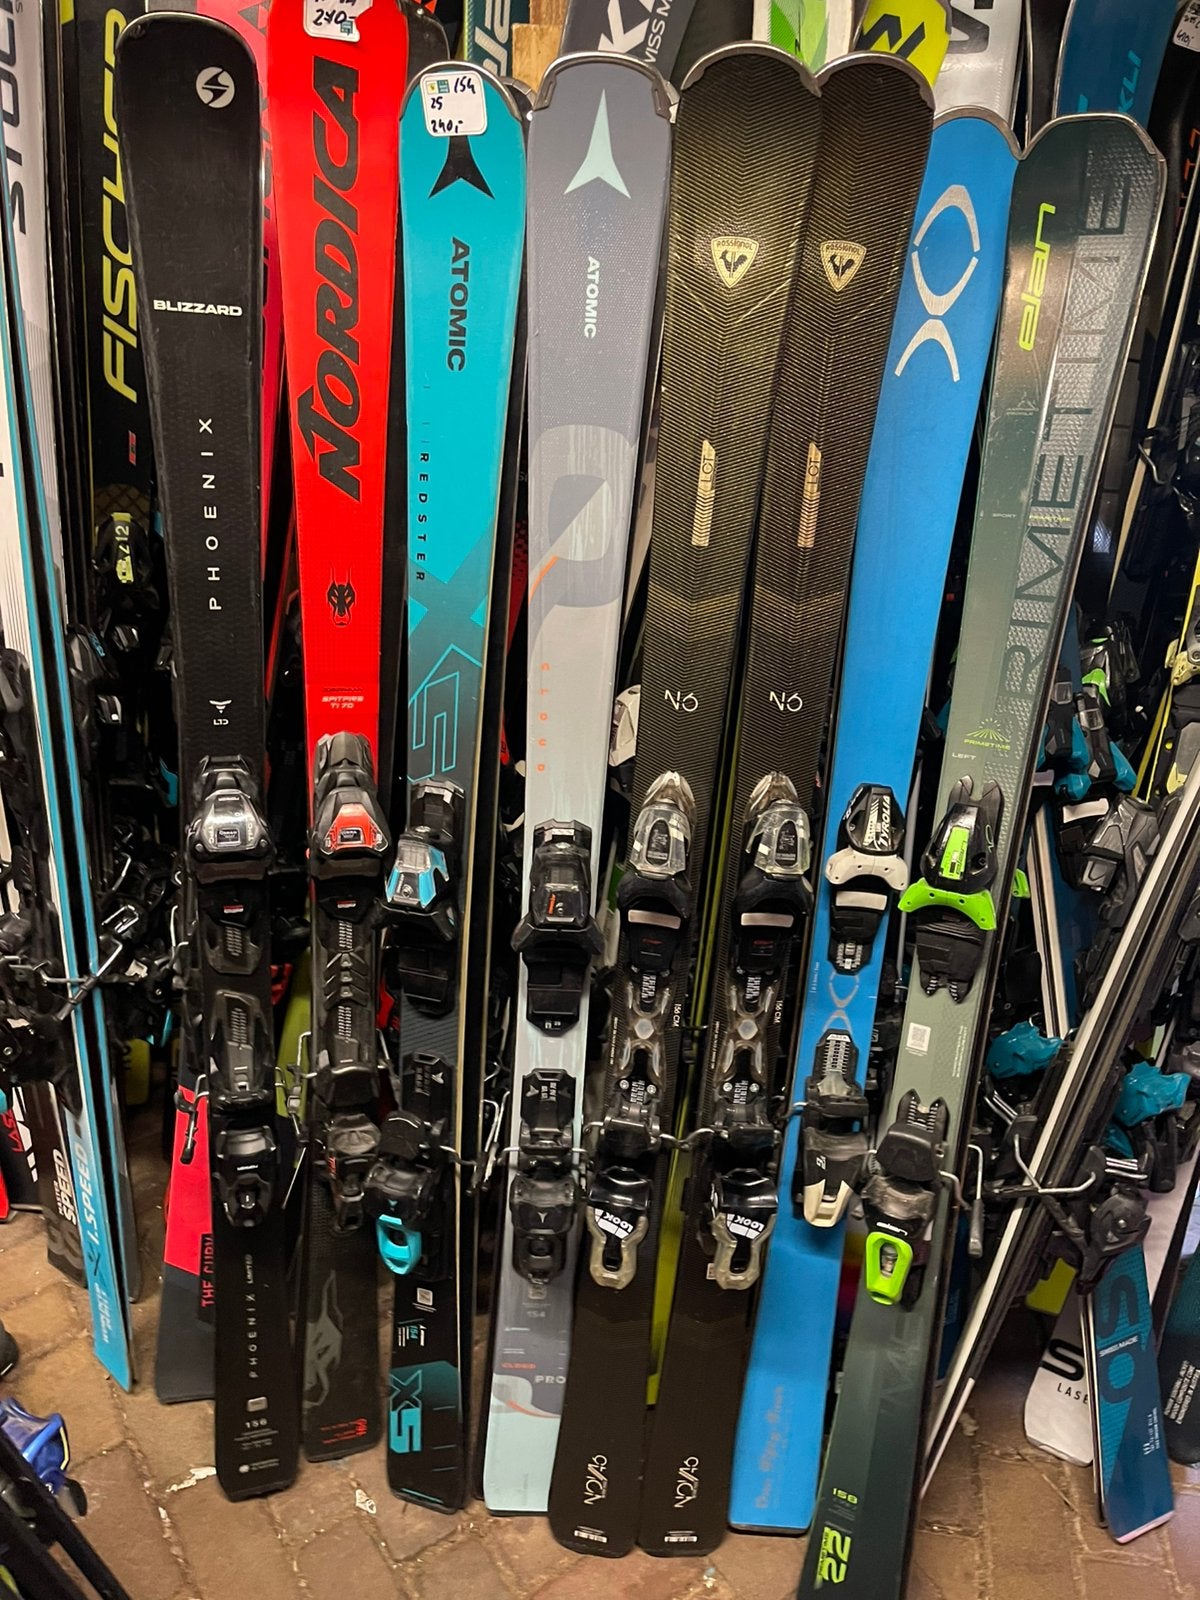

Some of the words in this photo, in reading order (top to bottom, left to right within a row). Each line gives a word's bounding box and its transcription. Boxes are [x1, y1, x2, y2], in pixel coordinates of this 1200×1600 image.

[153, 299, 243, 317] BLIZZARD
[296, 55, 361, 504] NORDICA
[447, 236, 470, 372] ATOMIC
[584, 256, 601, 339] ATOMIC
[1018, 202, 1056, 351] elan
[198, 417, 222, 611] PHOENIX
[415, 452, 430, 582] REDSTER
[877, 795, 892, 848] TYROLIA
[52, 1148, 77, 1225] SPEED
[603, 1211, 634, 1233] LOOK
[734, 1213, 765, 1233] LOOK
[534, 1375, 566, 1384] PRO
